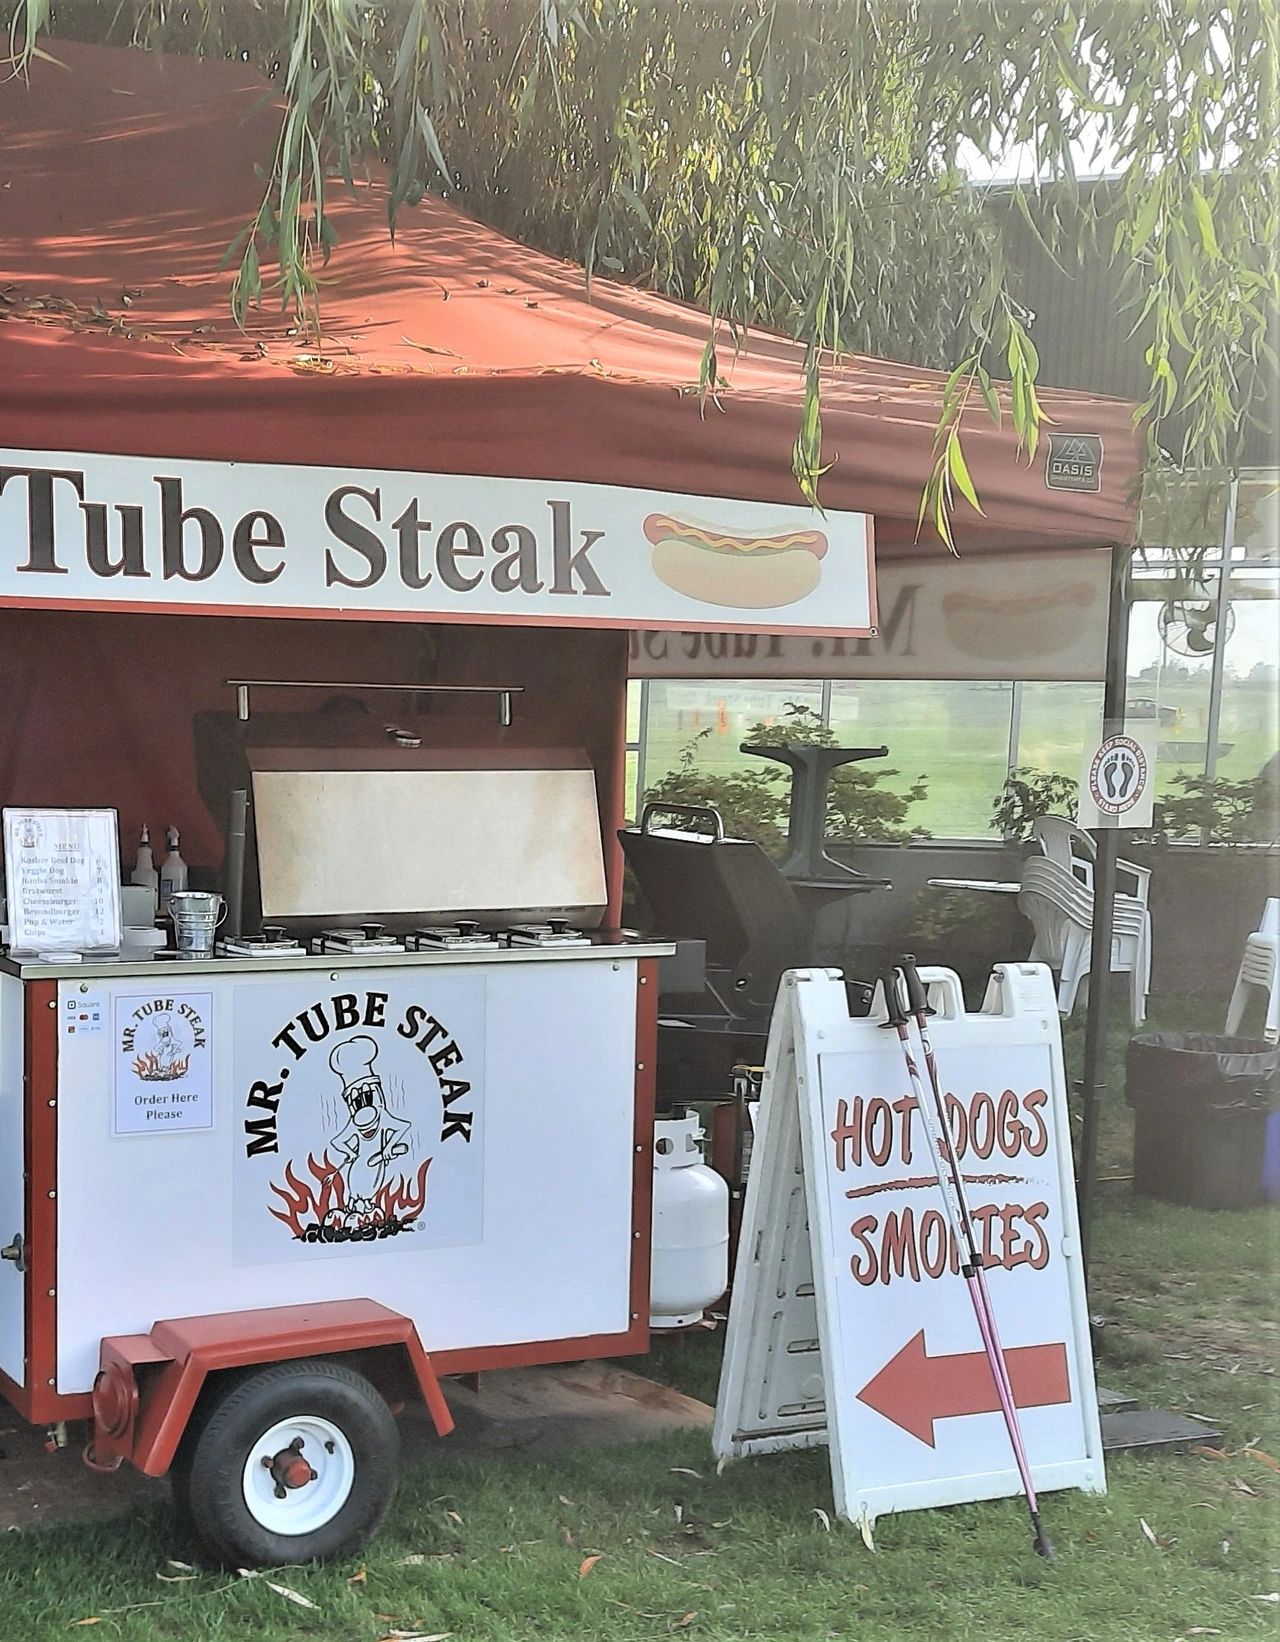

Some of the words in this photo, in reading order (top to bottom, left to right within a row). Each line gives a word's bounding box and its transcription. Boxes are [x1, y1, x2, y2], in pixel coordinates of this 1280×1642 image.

[1053, 462, 1093, 476] OASIS
[322, 485, 612, 597] Steak
[1115, 738, 1137, 751] SOCIAL
[49, 867, 65, 876] Dog
[122, 1023, 139, 1052] MR.
[132, 999, 175, 1022] TUBE
[177, 1003, 206, 1049] STEAK
[244, 1067, 291, 1158] MR.
[271, 991, 389, 1060] TUBE
[396, 1004, 474, 1144] STEAK
[134, 1093, 169, 1106] Order
[171, 1092, 199, 1104] Here
[146, 1109, 183, 1121] Please
[830, 1095, 920, 1171] HOT
[936, 1088, 1049, 1164] DOGS
